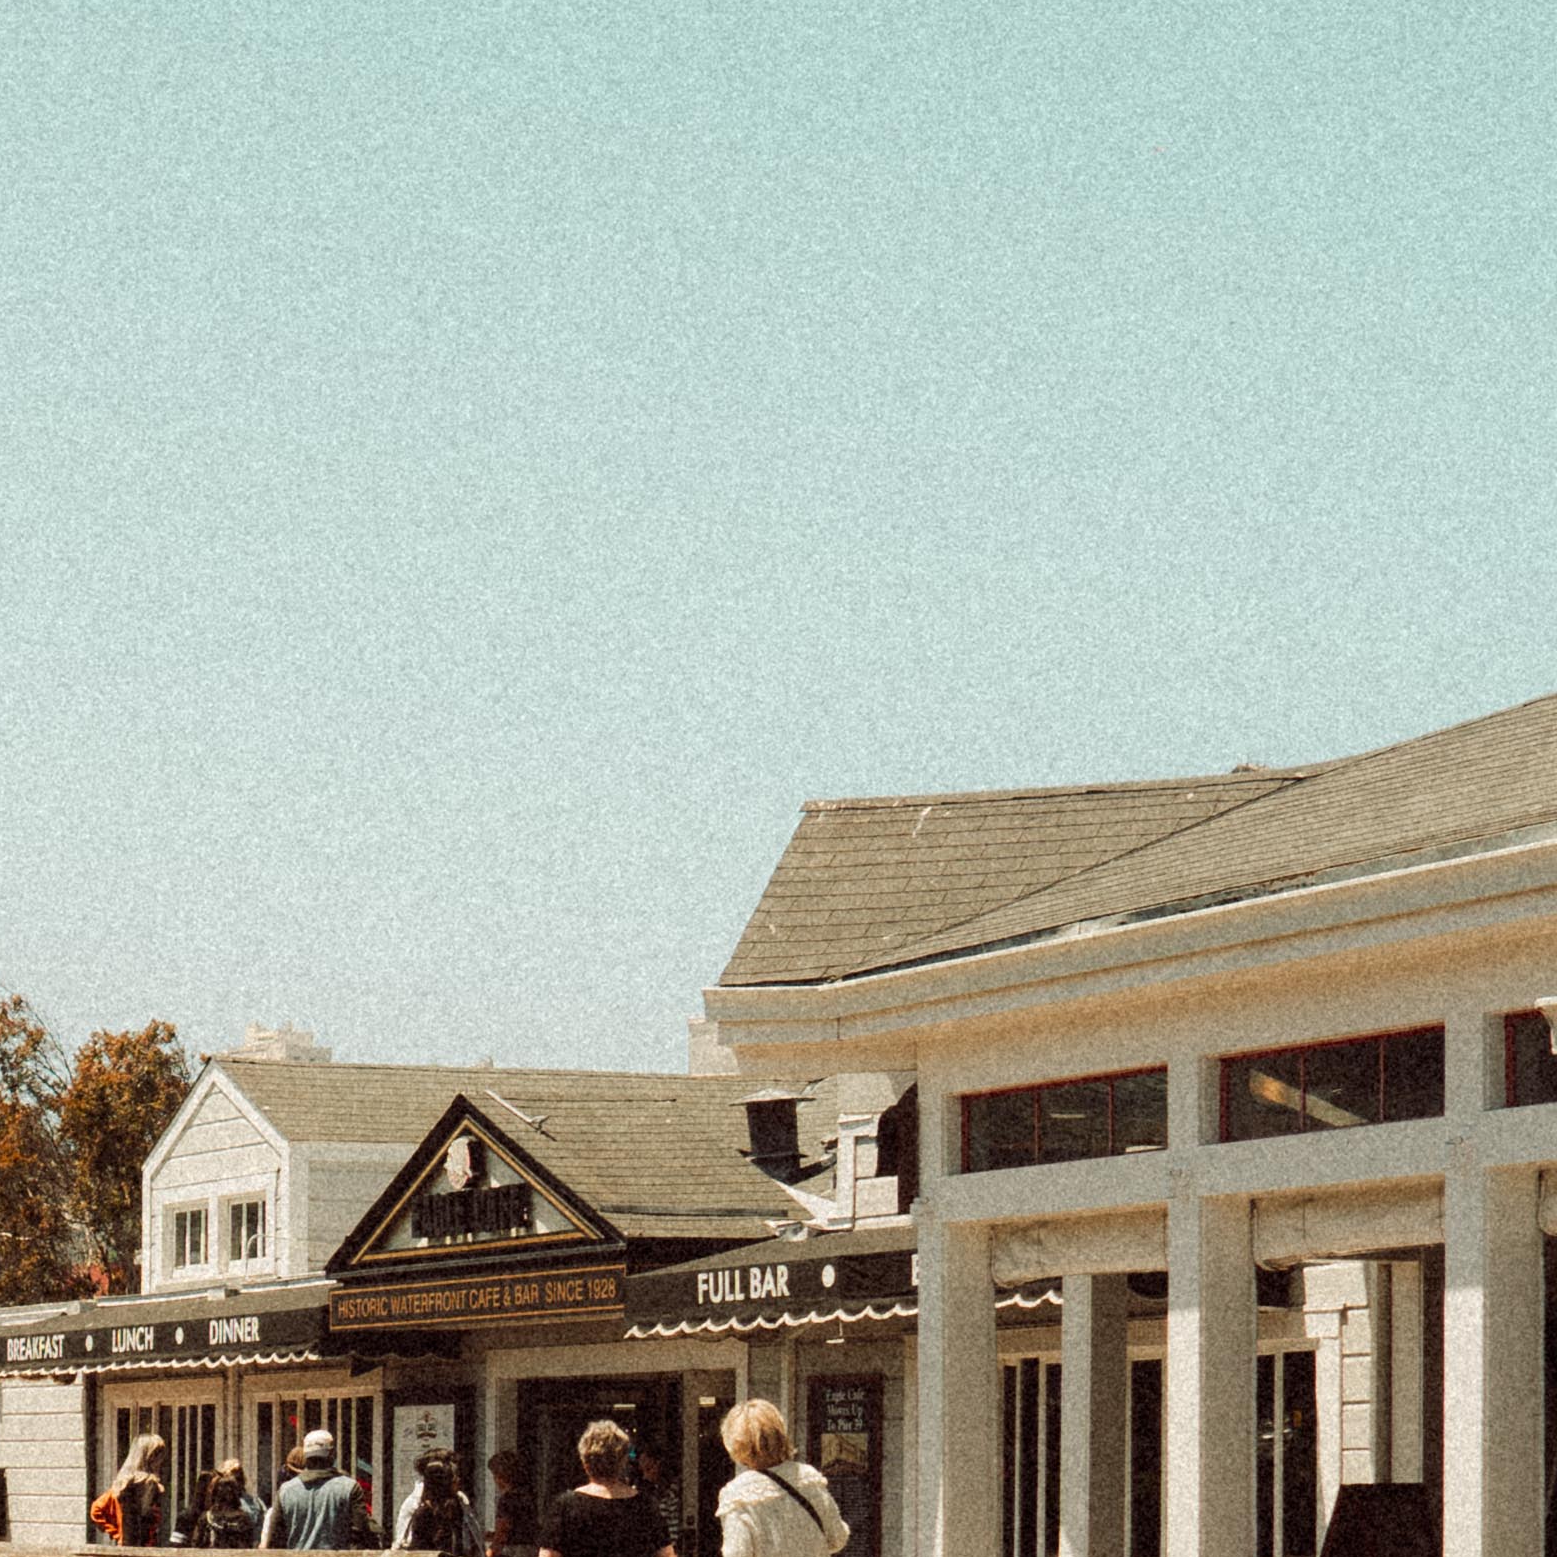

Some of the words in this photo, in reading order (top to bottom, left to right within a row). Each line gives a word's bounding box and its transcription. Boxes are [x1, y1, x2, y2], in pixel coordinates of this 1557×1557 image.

[337, 1297, 388, 1320] HISTORIC
[390, 1289, 467, 1316] WATERFRONT
[469, 1287, 502, 1309] CAFE
[515, 1283, 541, 1305] BAR
[545, 1280, 585, 1304] SINCE
[588, 1277, 618, 1300] 1928
[697, 1269, 745, 1305] FULL
[749, 1264, 790, 1300] BAR
[6, 1333, 65, 1362] BREAKFAST
[111, 1326, 154, 1353] LUNCH
[207, 1316, 260, 1346] DINNER
